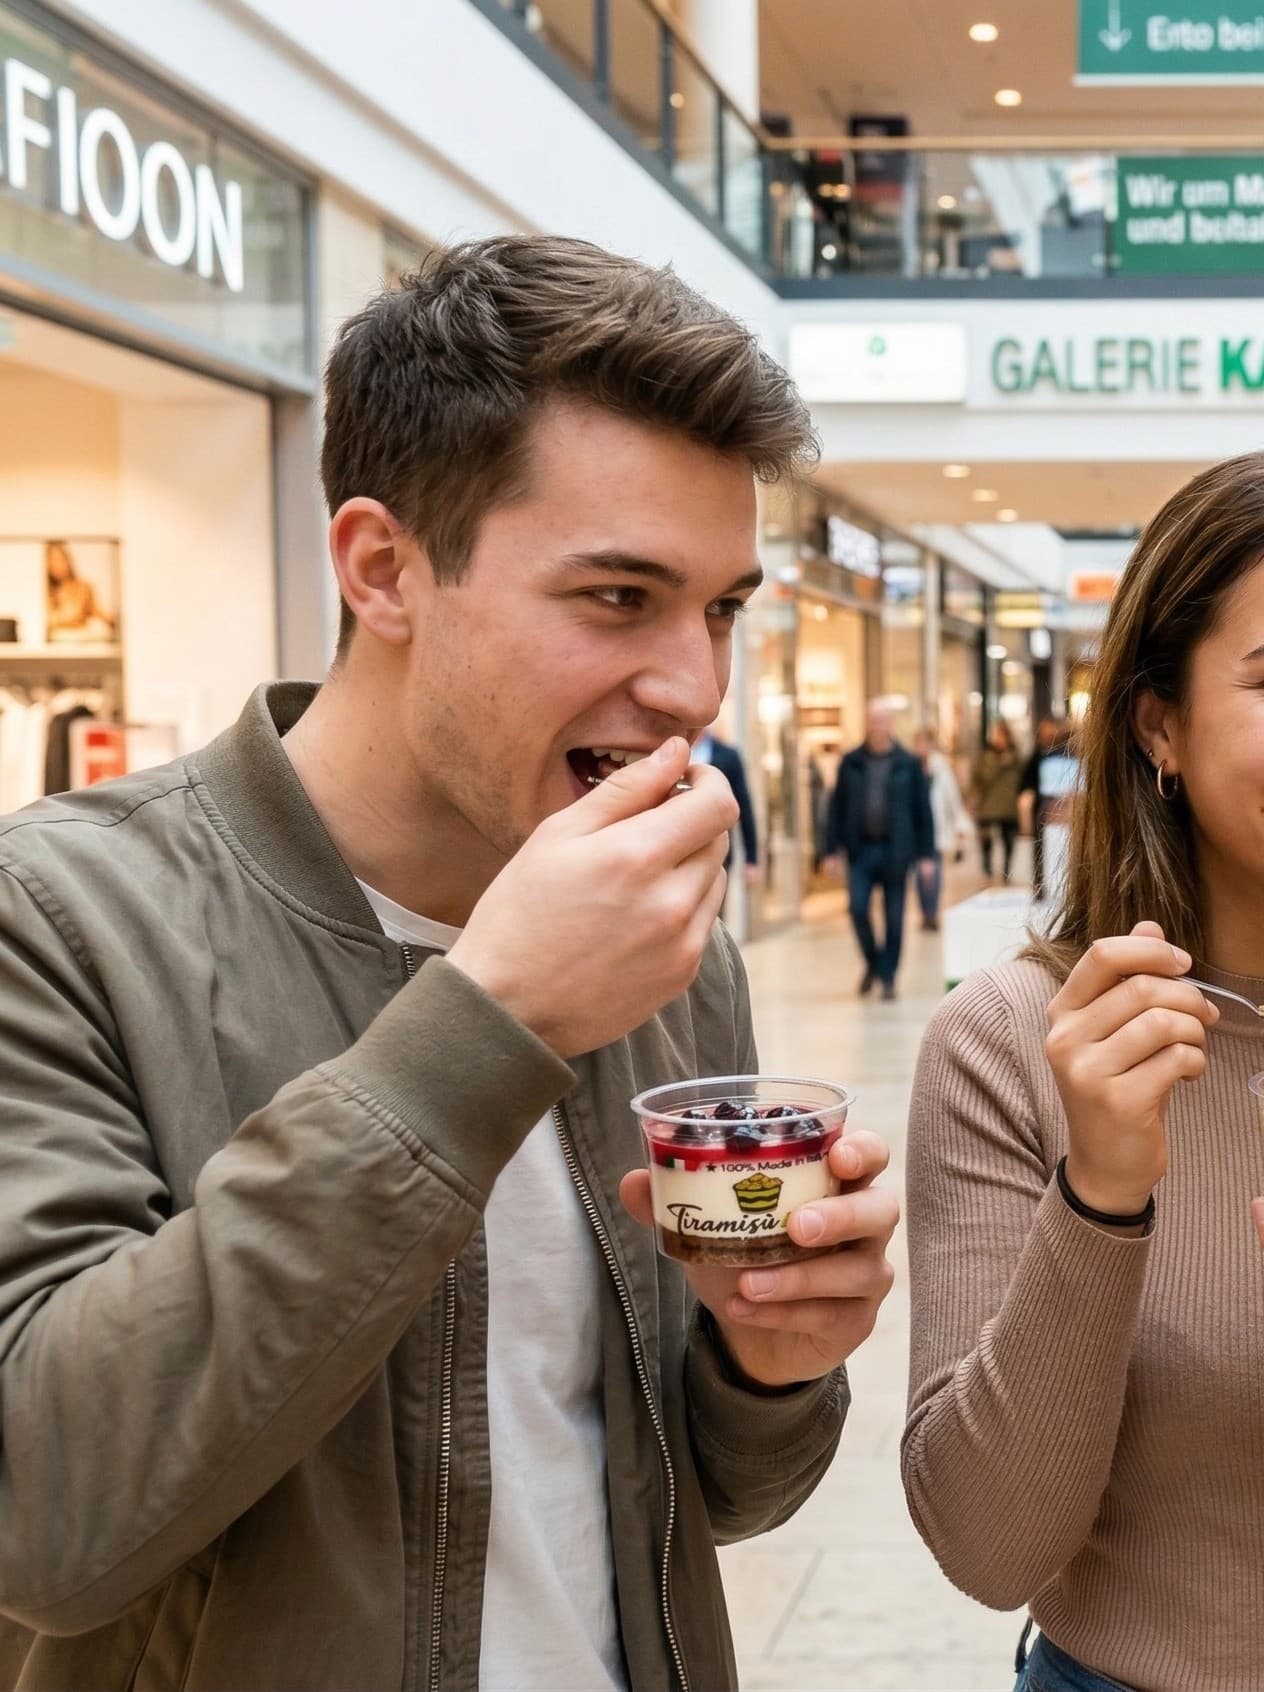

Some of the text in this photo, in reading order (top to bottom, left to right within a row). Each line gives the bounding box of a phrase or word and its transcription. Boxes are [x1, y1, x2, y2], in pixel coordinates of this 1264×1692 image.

[0, 57, 244, 293] FIOON
[1126, 211, 1185, 244] und
[990, 337, 1201, 393] GALERIE
[757, 1160, 792, 1171] Made
[666, 1202, 781, 1235] Tiramisù
